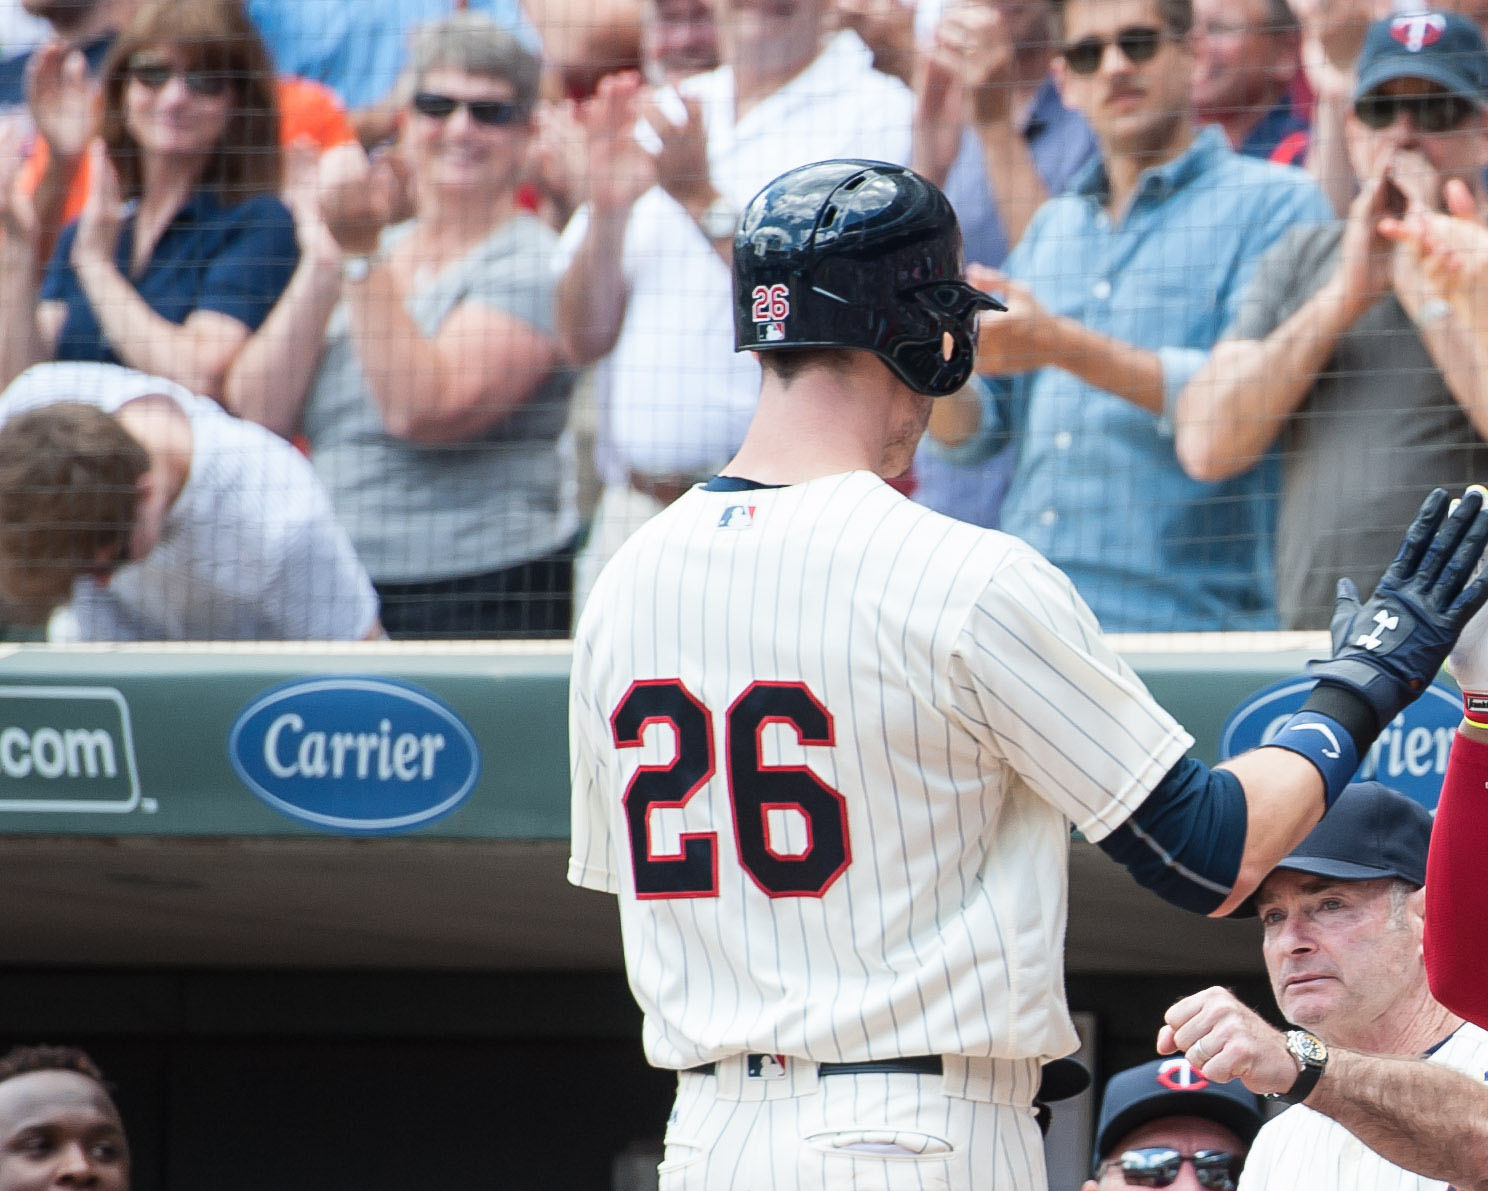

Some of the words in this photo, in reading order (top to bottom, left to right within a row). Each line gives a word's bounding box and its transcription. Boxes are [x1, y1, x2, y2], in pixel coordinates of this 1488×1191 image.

[752, 284, 790, 322] 26
[263, 713, 445, 781] Carrier
[610, 678, 852, 900] 26
